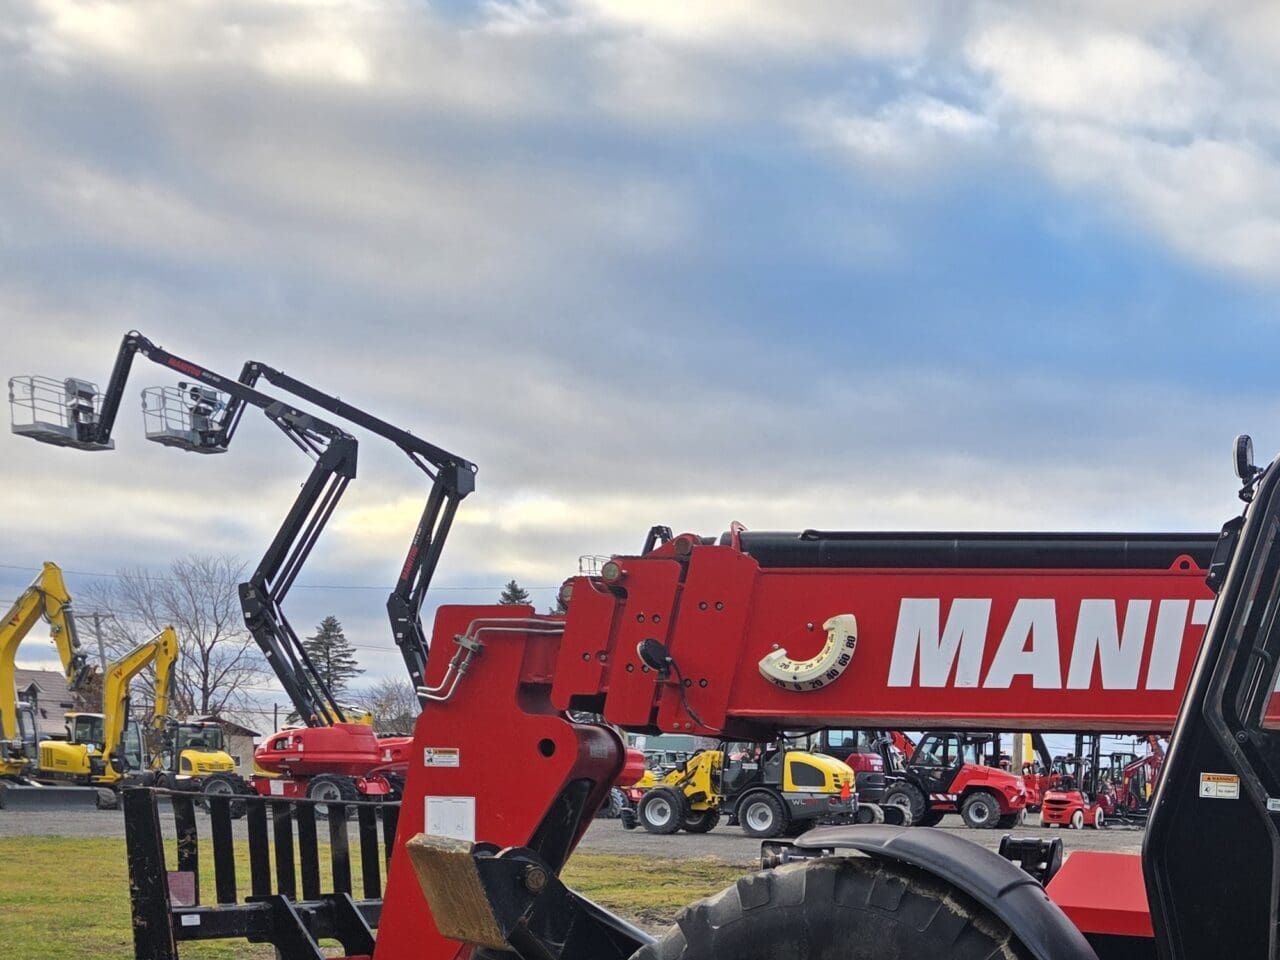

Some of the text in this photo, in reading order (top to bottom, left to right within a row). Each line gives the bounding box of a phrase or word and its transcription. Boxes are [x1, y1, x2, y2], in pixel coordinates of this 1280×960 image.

[809, 679, 823, 689] 20
[826, 668, 839, 680] 40
[838, 653, 851, 667] 60
[846, 635, 856, 649] 80
